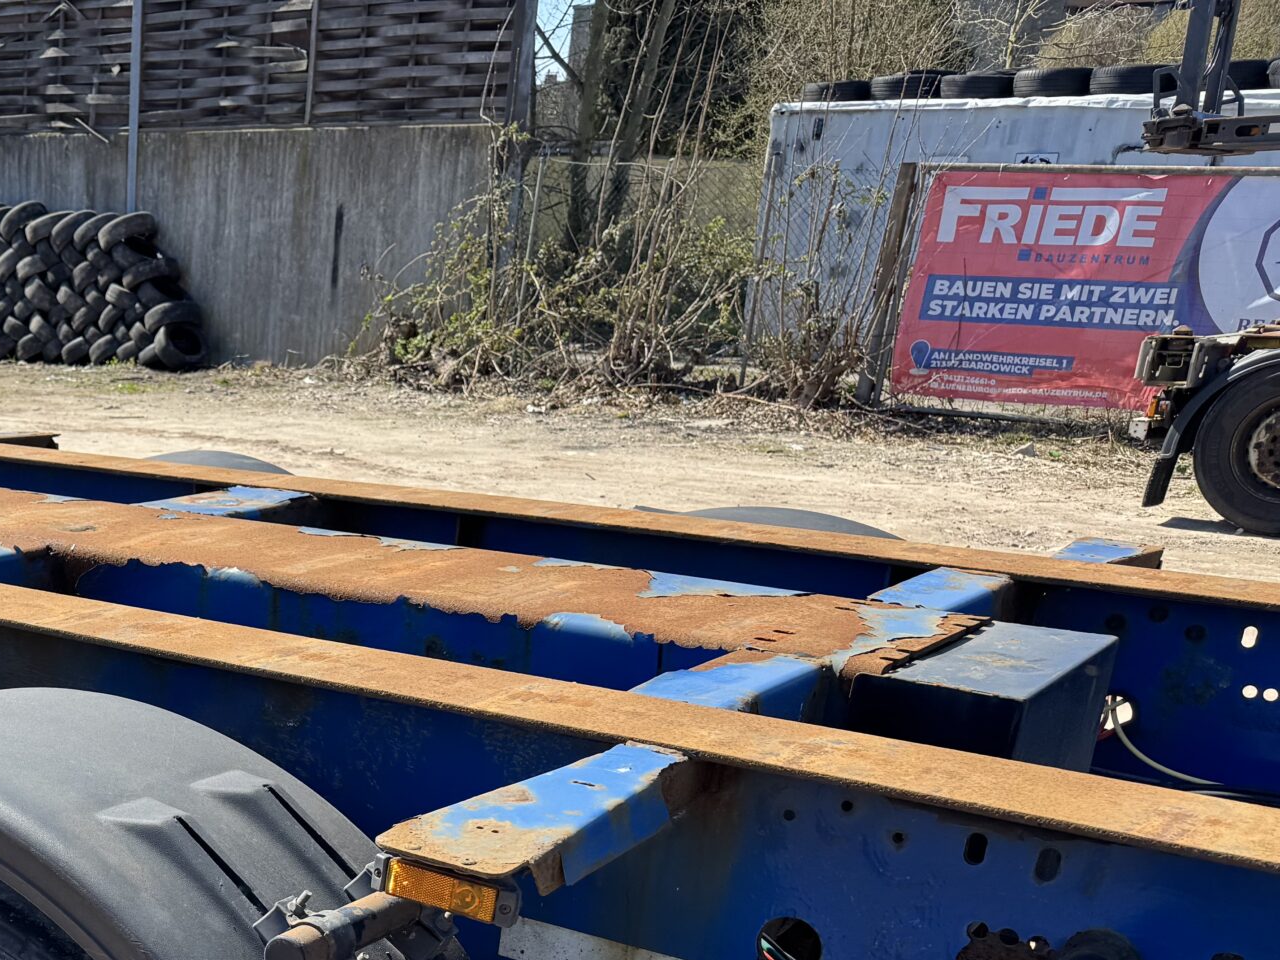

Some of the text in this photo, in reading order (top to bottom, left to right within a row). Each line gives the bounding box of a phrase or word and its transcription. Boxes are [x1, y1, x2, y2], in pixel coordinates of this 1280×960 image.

[1035, 252, 1150, 265] BAUZENTRUM
[933, 279, 1179, 305] BAUEN SIE MIT ZWEI
[928, 300, 1180, 326] STARKEN PARTNERN.
[960, 361, 1030, 374] BARDOWICK
